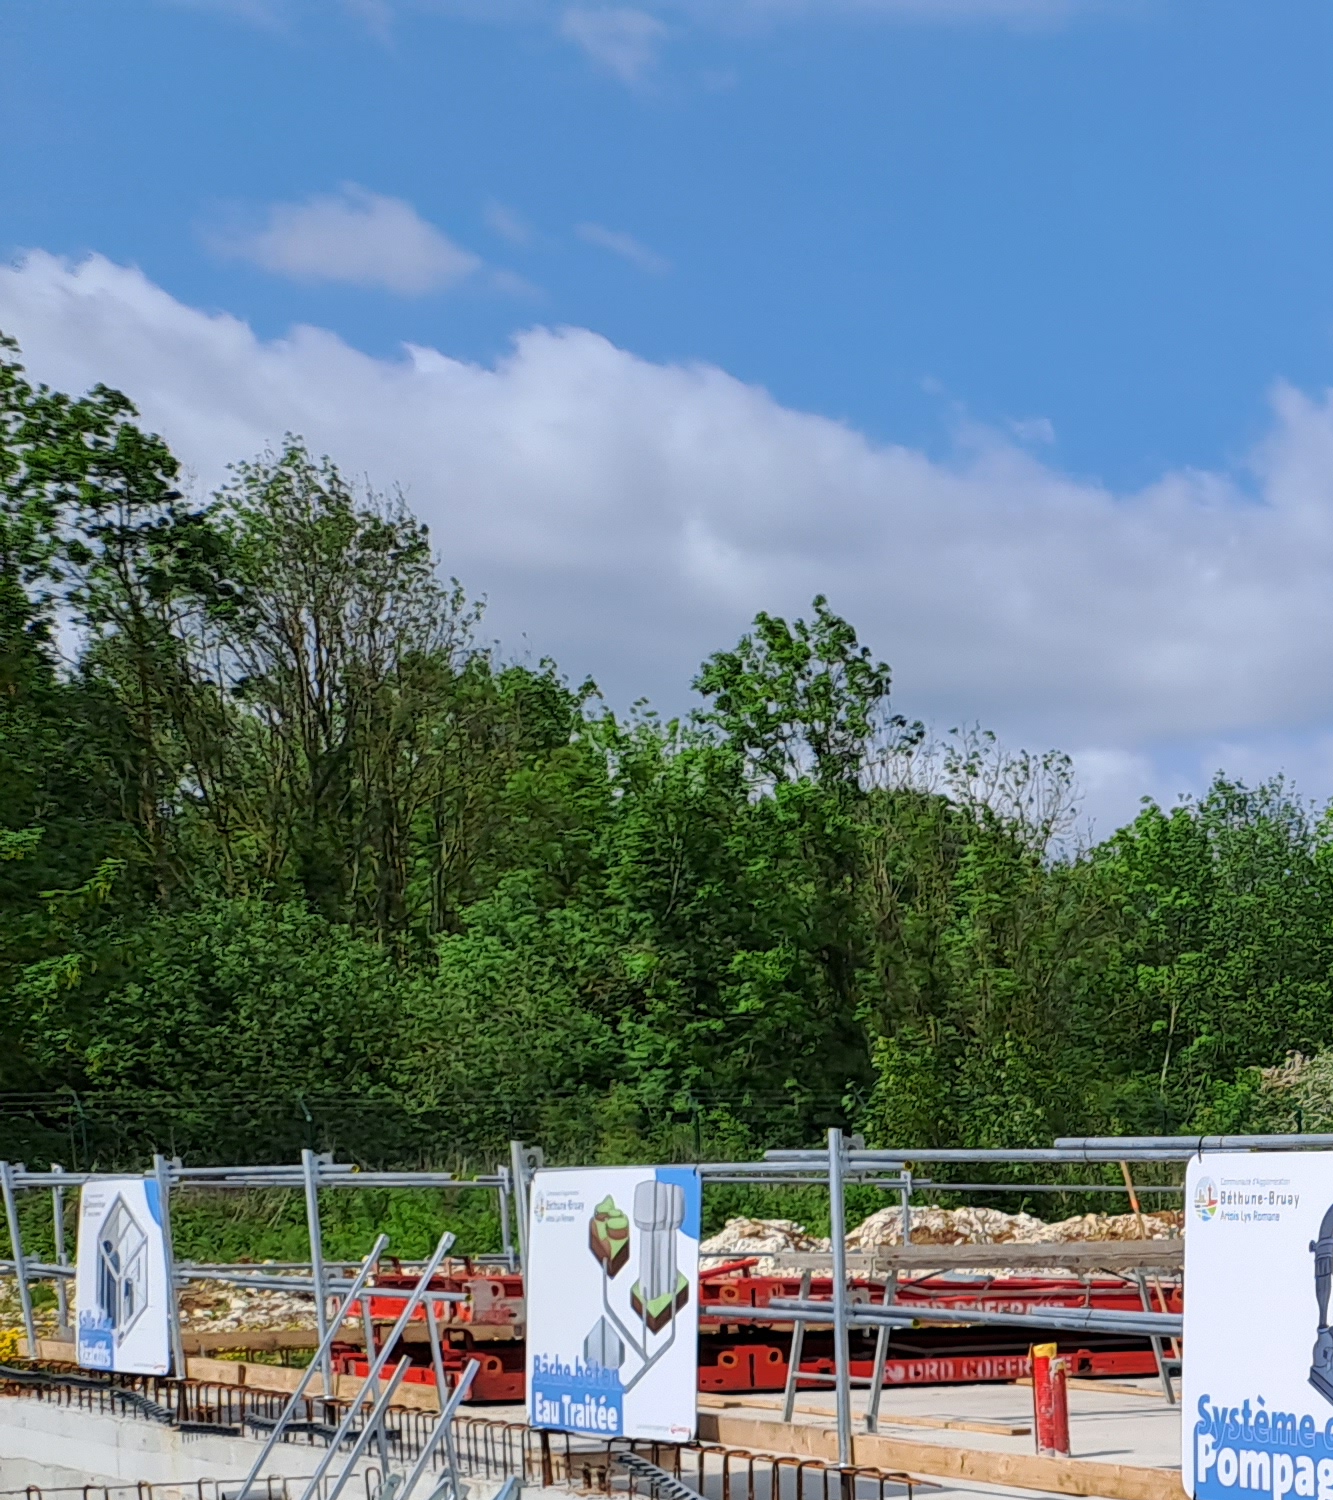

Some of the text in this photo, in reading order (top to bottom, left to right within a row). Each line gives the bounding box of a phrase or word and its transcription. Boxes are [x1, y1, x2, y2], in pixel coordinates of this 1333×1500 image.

[1220, 1190, 1300, 1209] Béthune-Bruay
[533, 1353, 571, 1385] Bâche
[535, 1391, 618, 1432] Eau Traitée
[1197, 1393, 1316, 1450] Système
